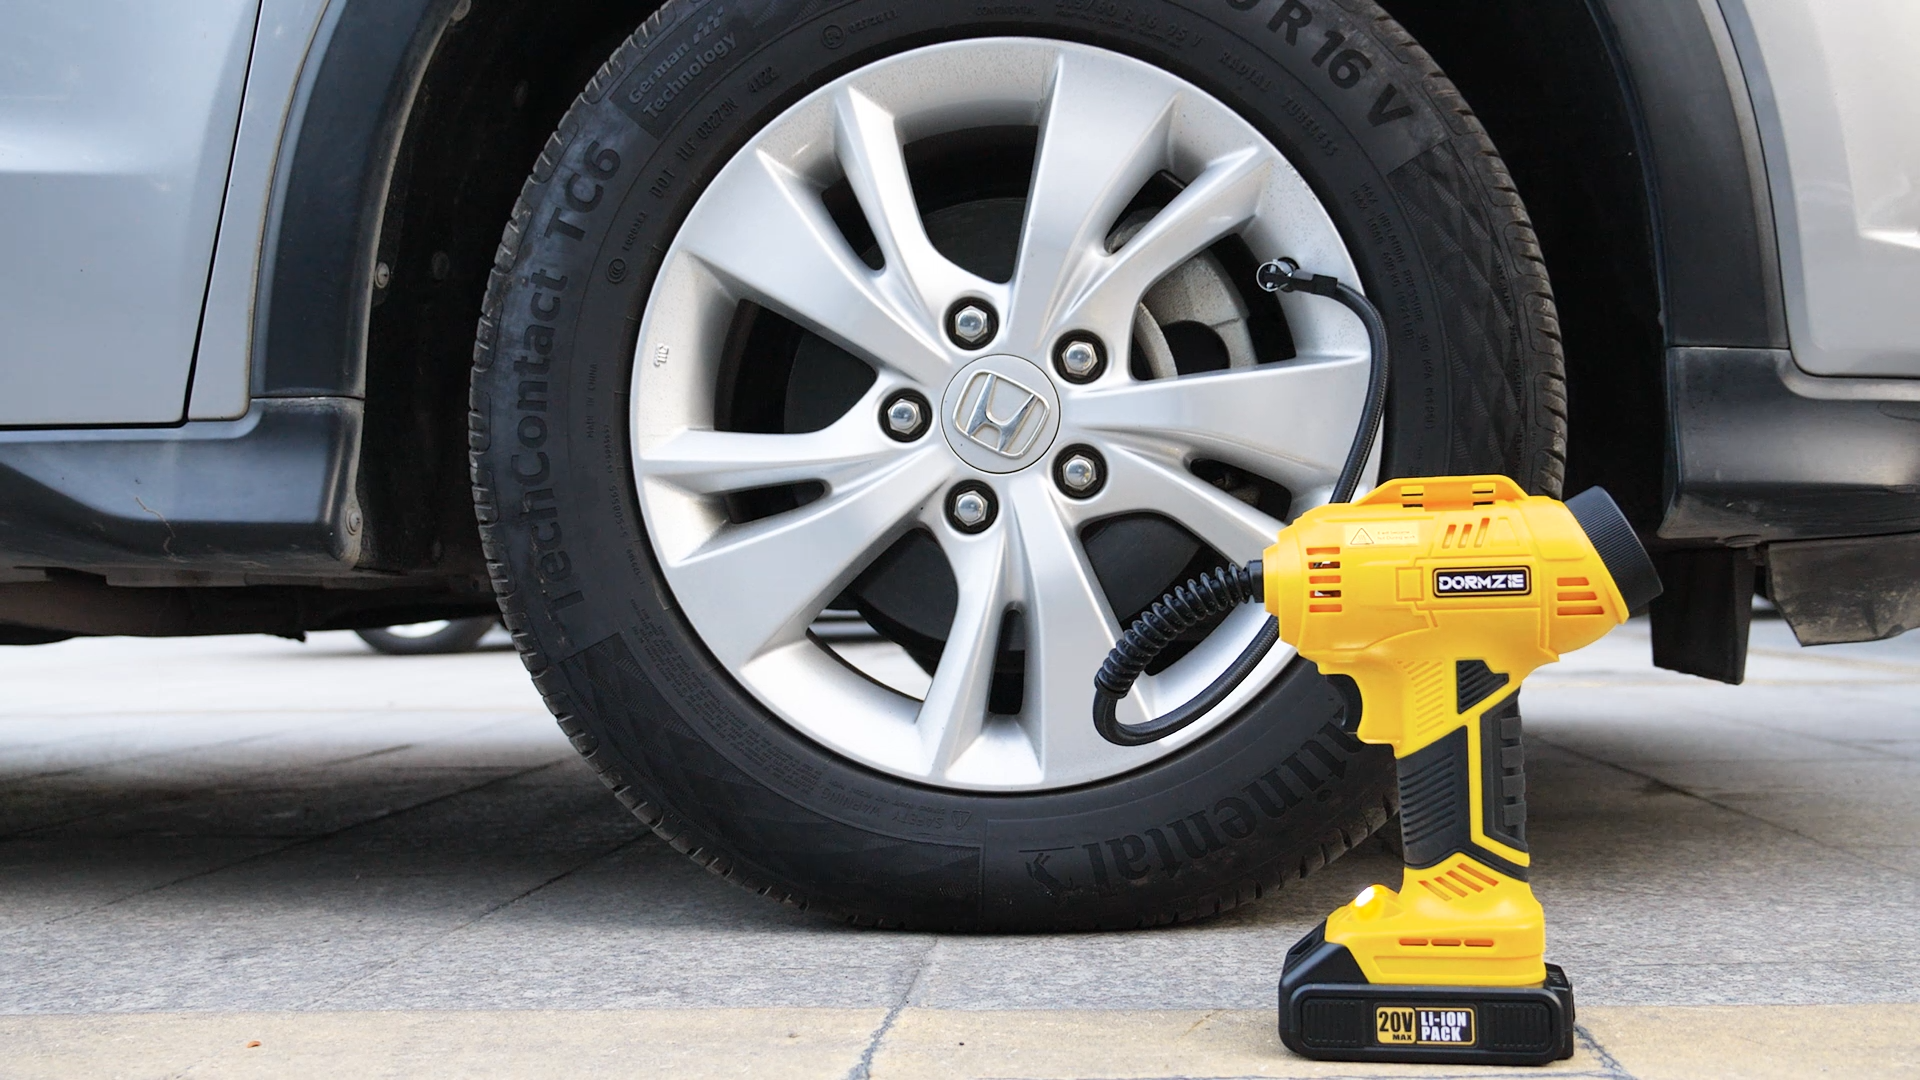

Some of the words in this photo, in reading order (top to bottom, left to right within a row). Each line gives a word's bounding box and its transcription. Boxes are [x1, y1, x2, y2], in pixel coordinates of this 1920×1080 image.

[628, 42, 689, 105] German
[642, 33, 738, 120] Technology
[1311, 29, 1373, 90] 16
[1364, 83, 1414, 128] V
[544, 142, 621, 243] TC6
[510, 268, 585, 614] TechContact
[822, 787, 881, 817] WARNING
[892, 810, 944, 830] SAFETY
[1081, 705, 1366, 897] ntinental
[1378, 1011, 1414, 1032] 20V
[1421, 1027, 1462, 1042] PACK
